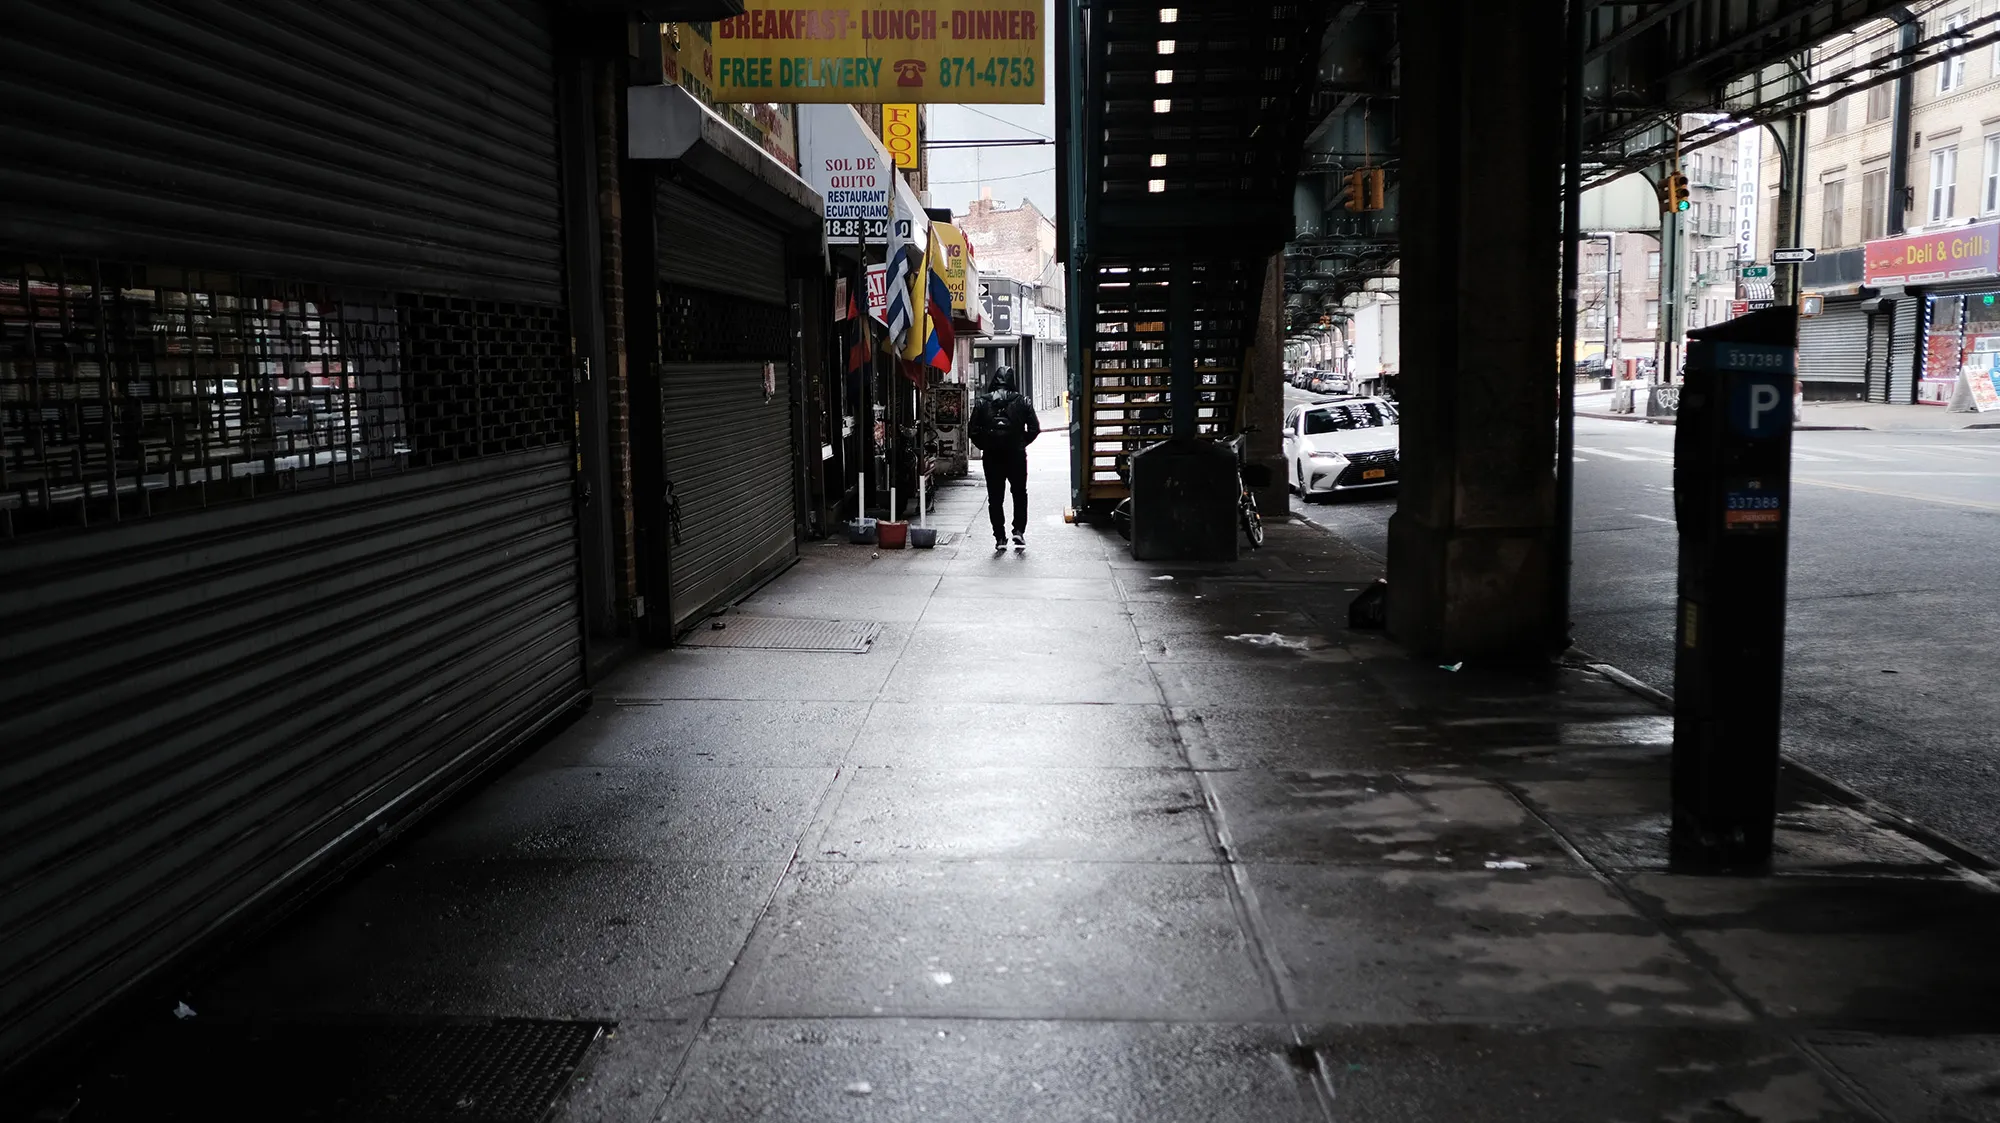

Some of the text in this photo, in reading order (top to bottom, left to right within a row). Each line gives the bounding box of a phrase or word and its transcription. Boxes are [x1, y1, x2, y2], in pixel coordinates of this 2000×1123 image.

[719, 57, 772, 87] FREE
[780, 57, 883, 87] DELIVERY
[939, 57, 1035, 87] 871-4753
[887, 107, 912, 166] FOOD
[825, 157, 875, 172] SOL DE
[831, 175, 875, 188] QUITO
[828, 190, 886, 203] RESTAURANT
[826, 205, 888, 218] ECUATORIANO
[1907, 243, 1932, 265] Deli
[1937, 241, 1947, 261] &
[1952, 235, 1982, 259] Grill
[1747, 268, 1756, 276] 45
[1729, 353, 1783, 367] 337388
[1749, 384, 1780, 430] P
